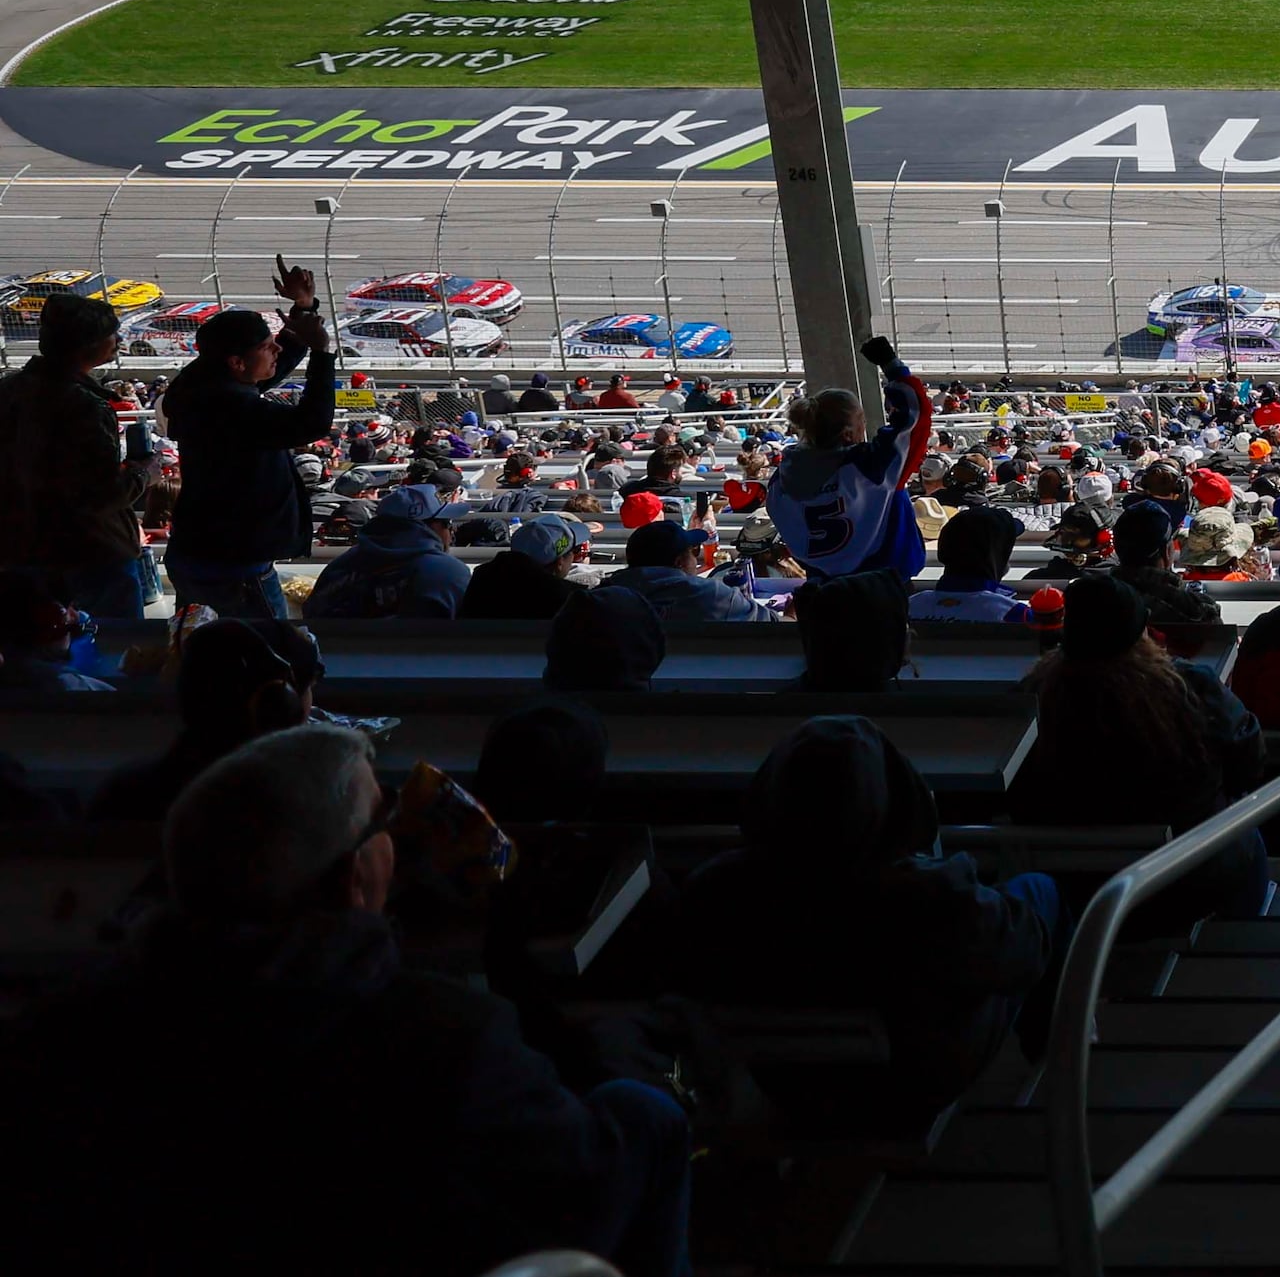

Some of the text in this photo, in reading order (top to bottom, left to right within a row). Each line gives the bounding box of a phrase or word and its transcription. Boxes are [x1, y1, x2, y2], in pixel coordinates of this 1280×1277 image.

[385, 12, 602, 31] Freeway
[365, 29, 577, 37] INSURANCE
[294, 46, 549, 74] xfinity
[157, 105, 727, 144] EchoPark
[166, 149, 632, 171] SPEEDWAY
[788, 167, 818, 182] 246
[751, 386, 774, 396] 144
[803, 499, 853, 558] 5
